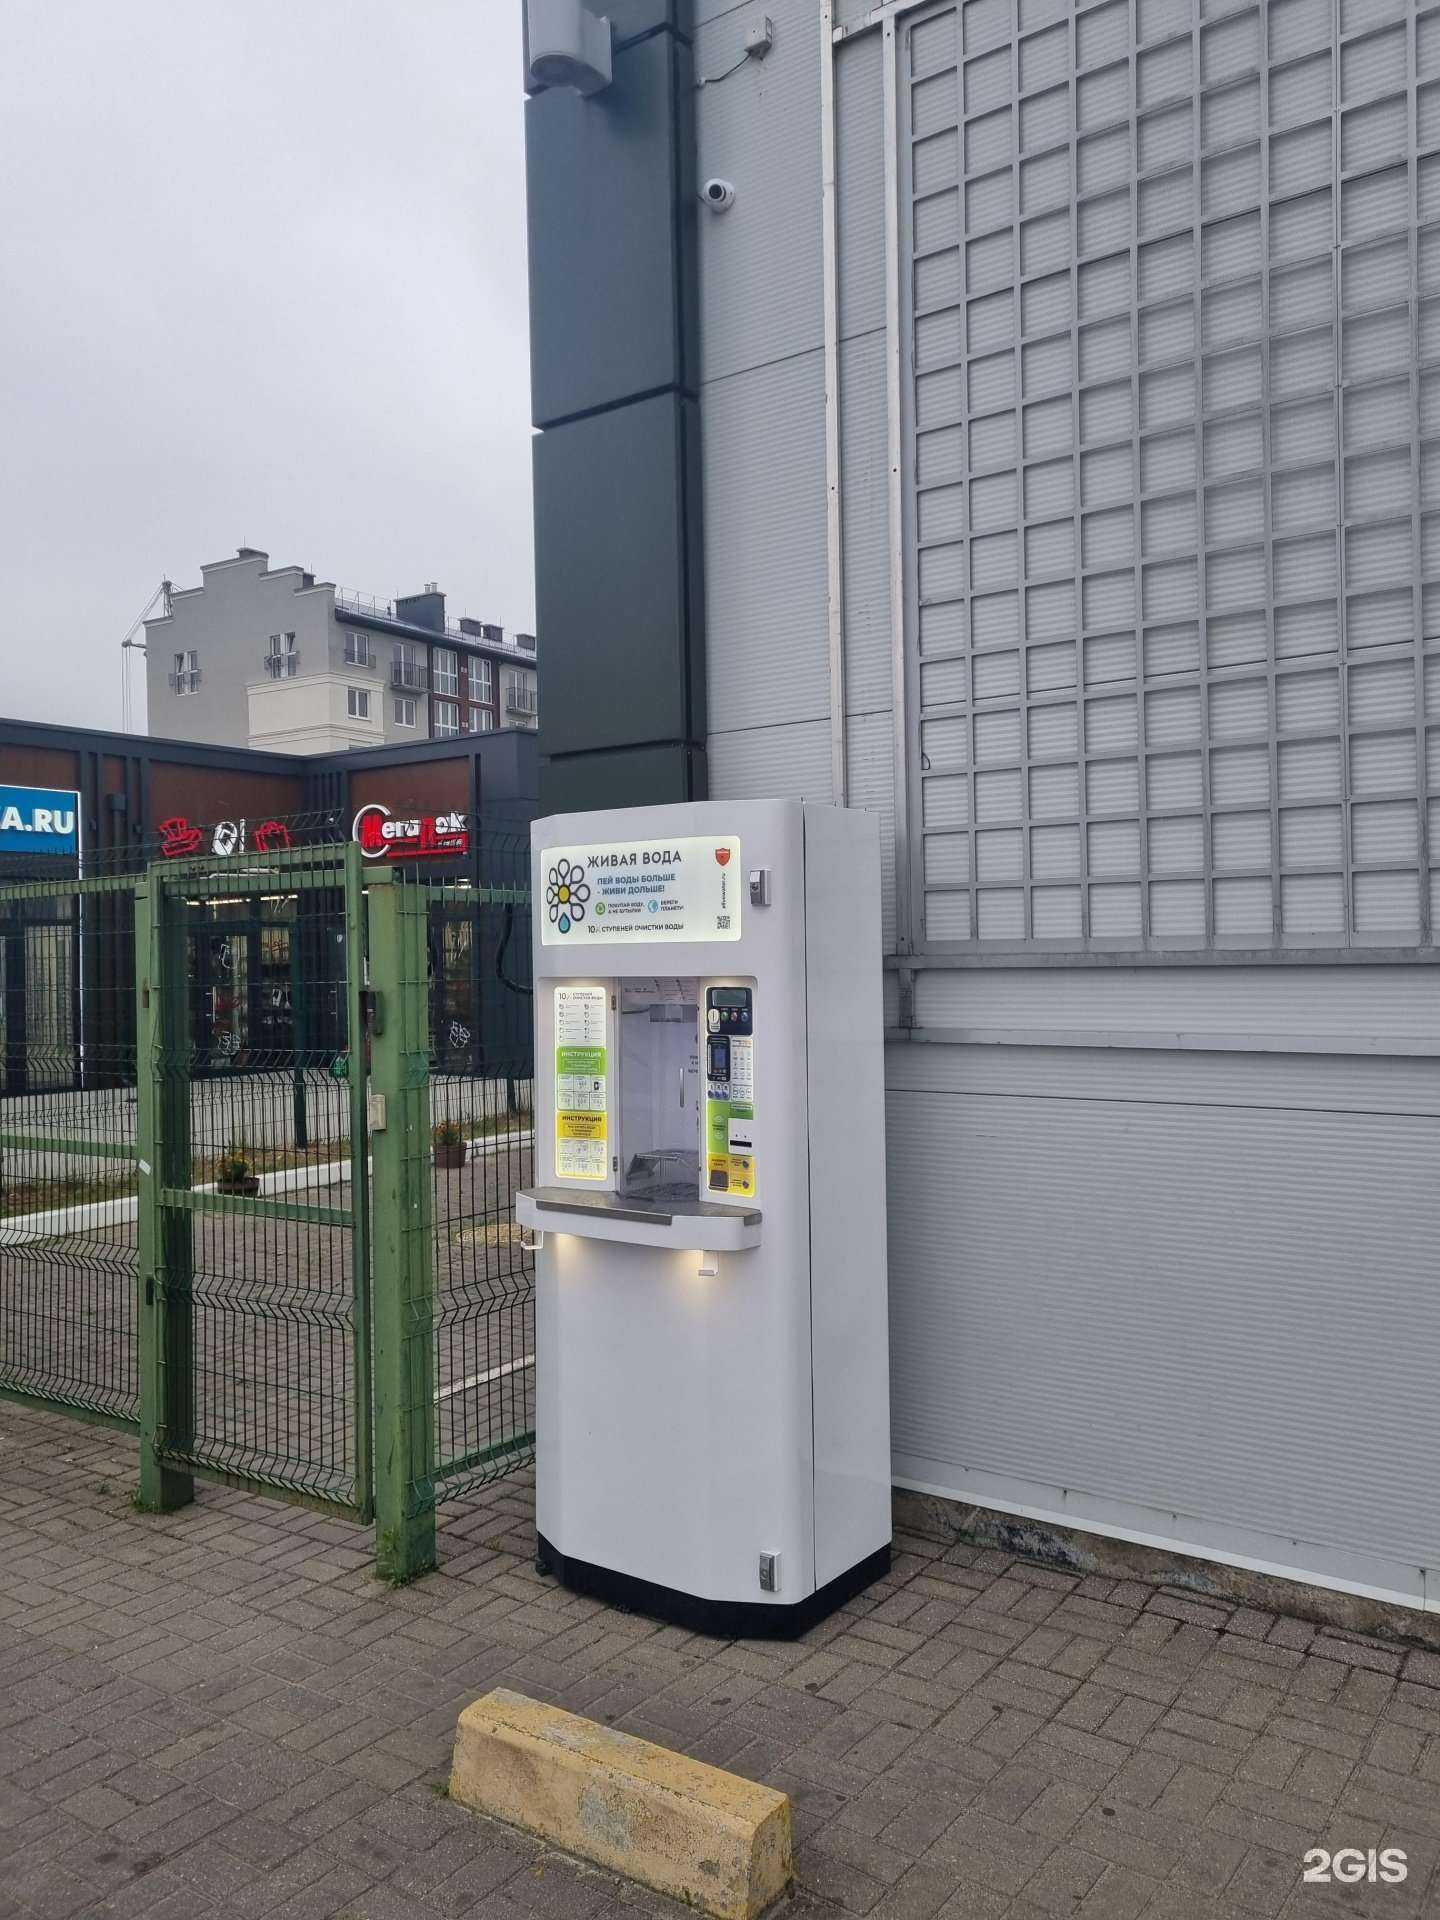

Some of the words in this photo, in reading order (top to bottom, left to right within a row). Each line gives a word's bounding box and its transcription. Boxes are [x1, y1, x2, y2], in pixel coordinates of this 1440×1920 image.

[0, 806, 74, 834] A.RU
[587, 853, 637, 868] ЖИВАЯ
[642, 850, 682, 865] ВОДА
[597, 875, 613, 885] ПЕЙ
[615, 875, 639, 885] ВОДЫ
[641, 873, 676, 883] БОЛЬШЕ
[602, 887, 627, 896] ЖИВИ
[628, 885, 665, 895] ДОЛЬШЕ!
[602, 925, 633, 933] СТУПЕНЕЙ
[635, 924, 663, 932] ОЧИСТКИ
[665, 923, 684, 931] ВОДЫ
